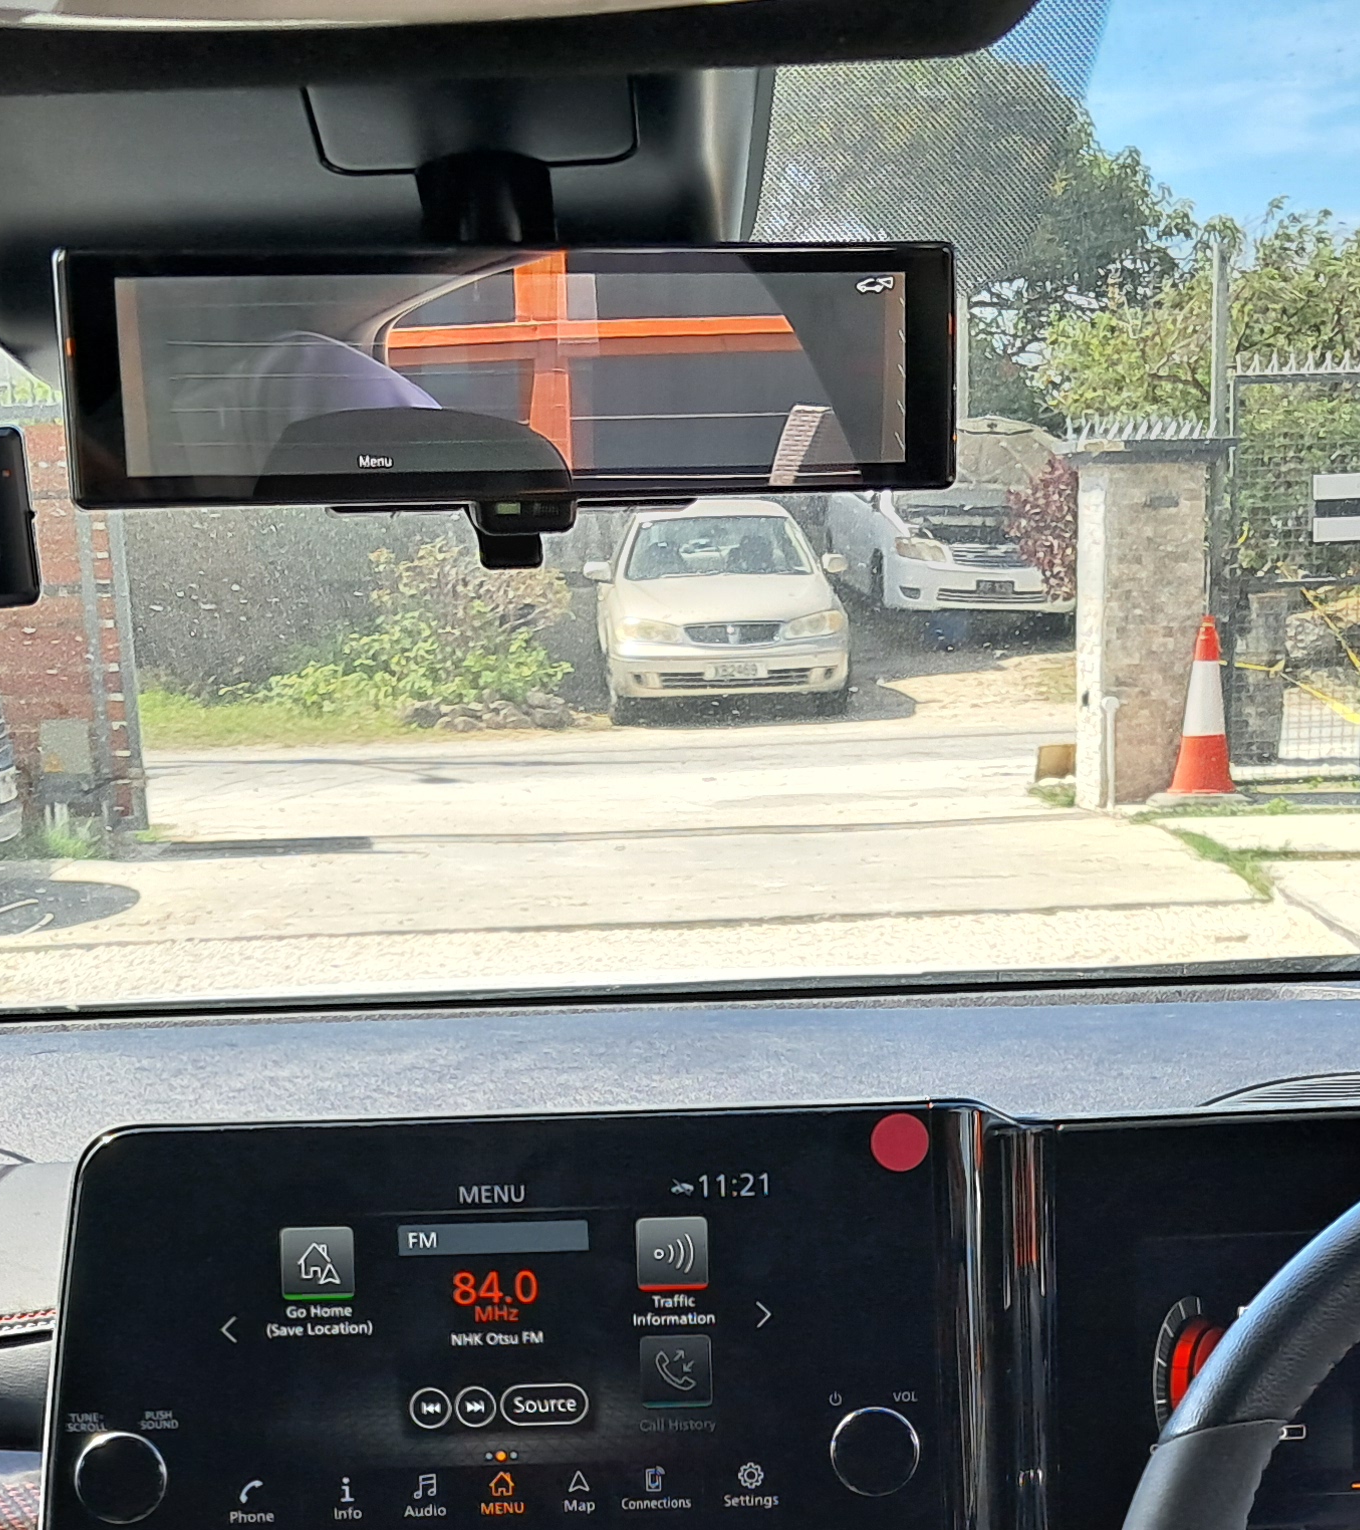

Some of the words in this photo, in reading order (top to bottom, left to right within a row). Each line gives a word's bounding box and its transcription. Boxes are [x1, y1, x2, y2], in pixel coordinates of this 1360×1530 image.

[359, 455, 392, 467] Menu
[698, 1173, 770, 1198] 11:21
[459, 1185, 525, 1203] MENU
[408, 1233, 438, 1249] FM
[453, 1270, 538, 1304] 84.0
[652, 1294, 696, 1309] Traffic
[286, 1306, 307, 1319] Go
[310, 1304, 353, 1318] Home
[475, 1306, 519, 1322] MHz
[632, 1310, 716, 1326] Information
[266, 1322, 305, 1339] (Save
[308, 1320, 373, 1337] Location)
[451, 1333, 483, 1347] NHK
[486, 1331, 518, 1345] Otsu
[522, 1330, 544, 1344] FM
[513, 1395, 577, 1414] Source
[893, 1391, 918, 1403] VOL
[144, 1410, 173, 1421] PUSH
[66, 1421, 108, 1432] SCROLL
[140, 1419, 179, 1430] SOUND
[640, 1418, 663, 1432] Call
[668, 1417, 717, 1433] History
[564, 1499, 596, 1515] Map
[621, 1496, 692, 1510] Connections
[723, 1493, 780, 1508] Settings
[229, 1510, 275, 1523] Phone
[333, 1507, 362, 1520] Info
[403, 1504, 447, 1518] Audio
[480, 1502, 525, 1516] MENU
